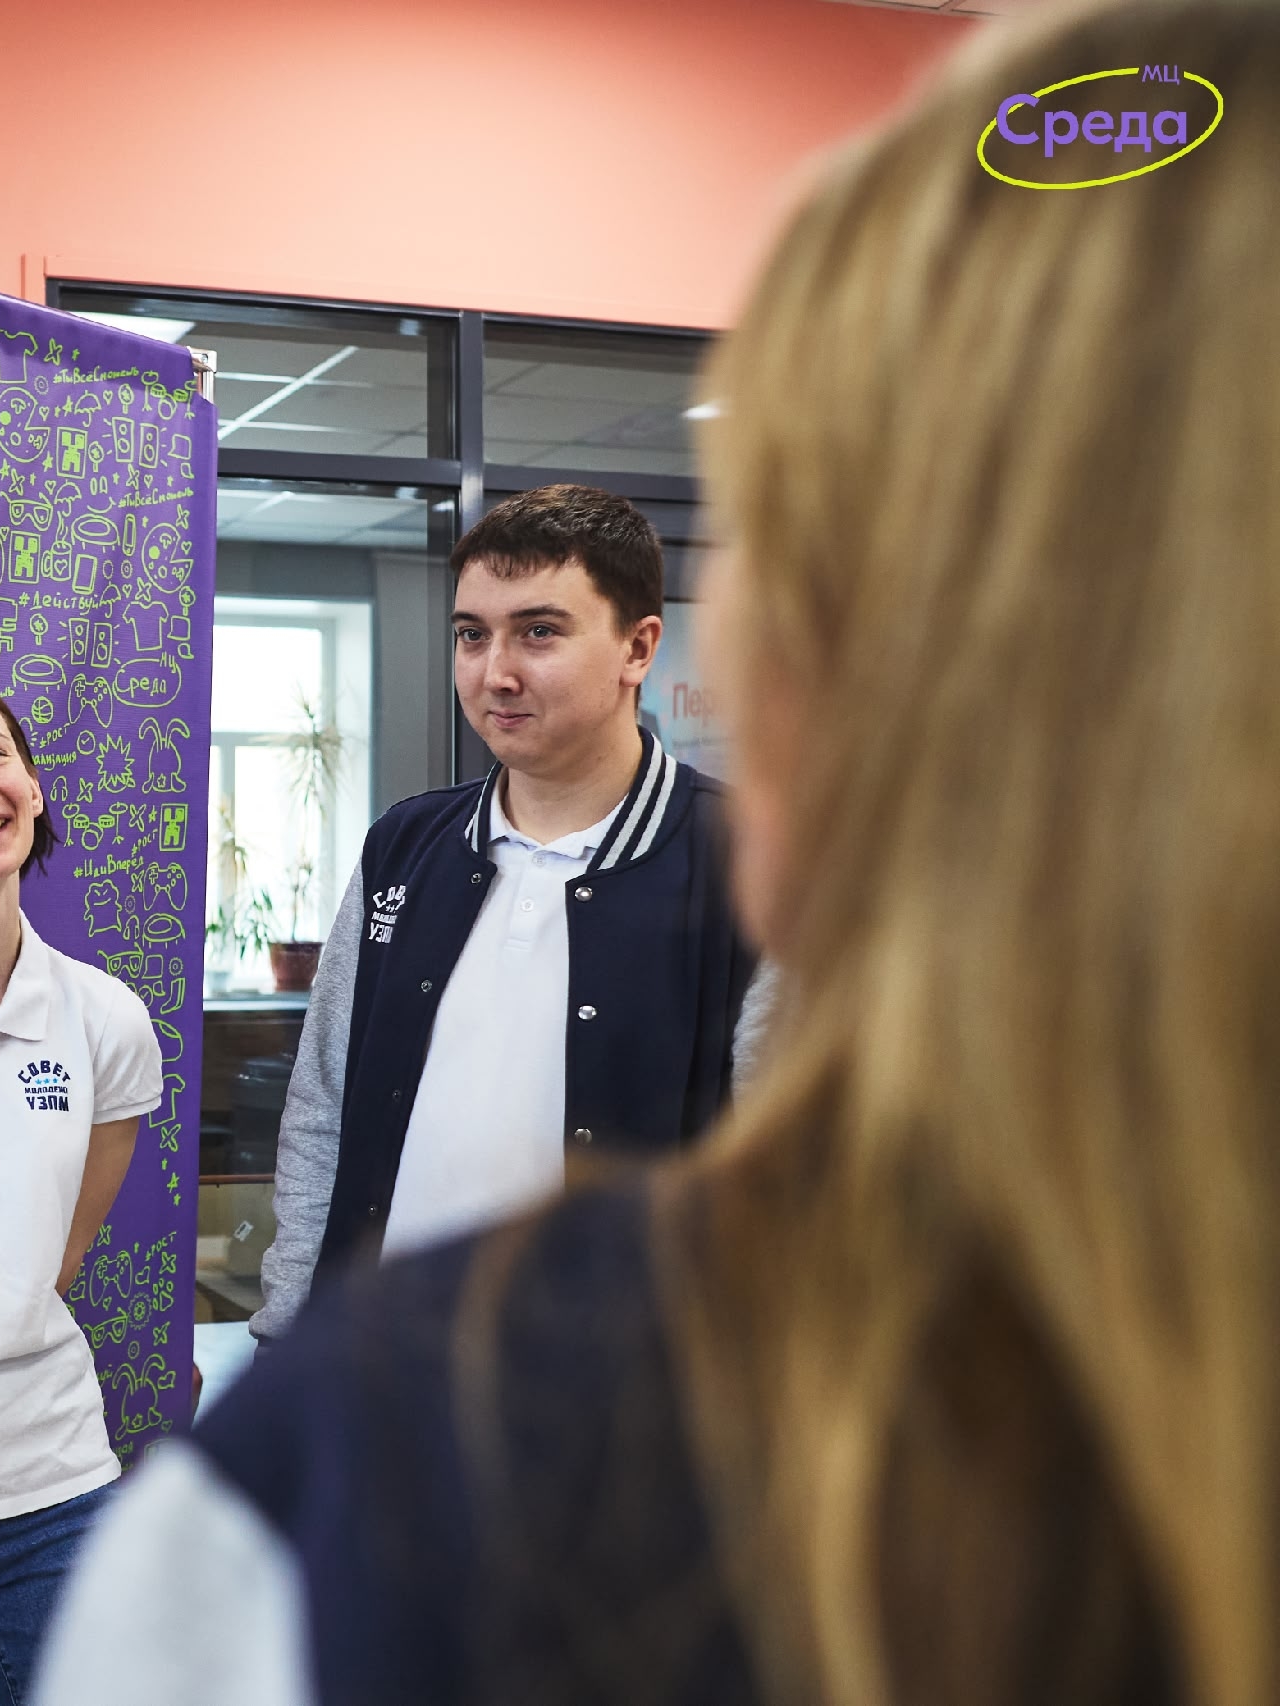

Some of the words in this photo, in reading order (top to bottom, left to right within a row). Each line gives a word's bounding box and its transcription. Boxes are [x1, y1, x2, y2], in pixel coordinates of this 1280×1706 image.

[19, 591, 98, 616] #Действуй
[31, 751, 77, 771] ализация
[73, 854, 144, 878] #ИдиВперёд
[17, 1060, 71, 1084] СОВЕТ
[25, 1095, 70, 1112] УЗПМ
